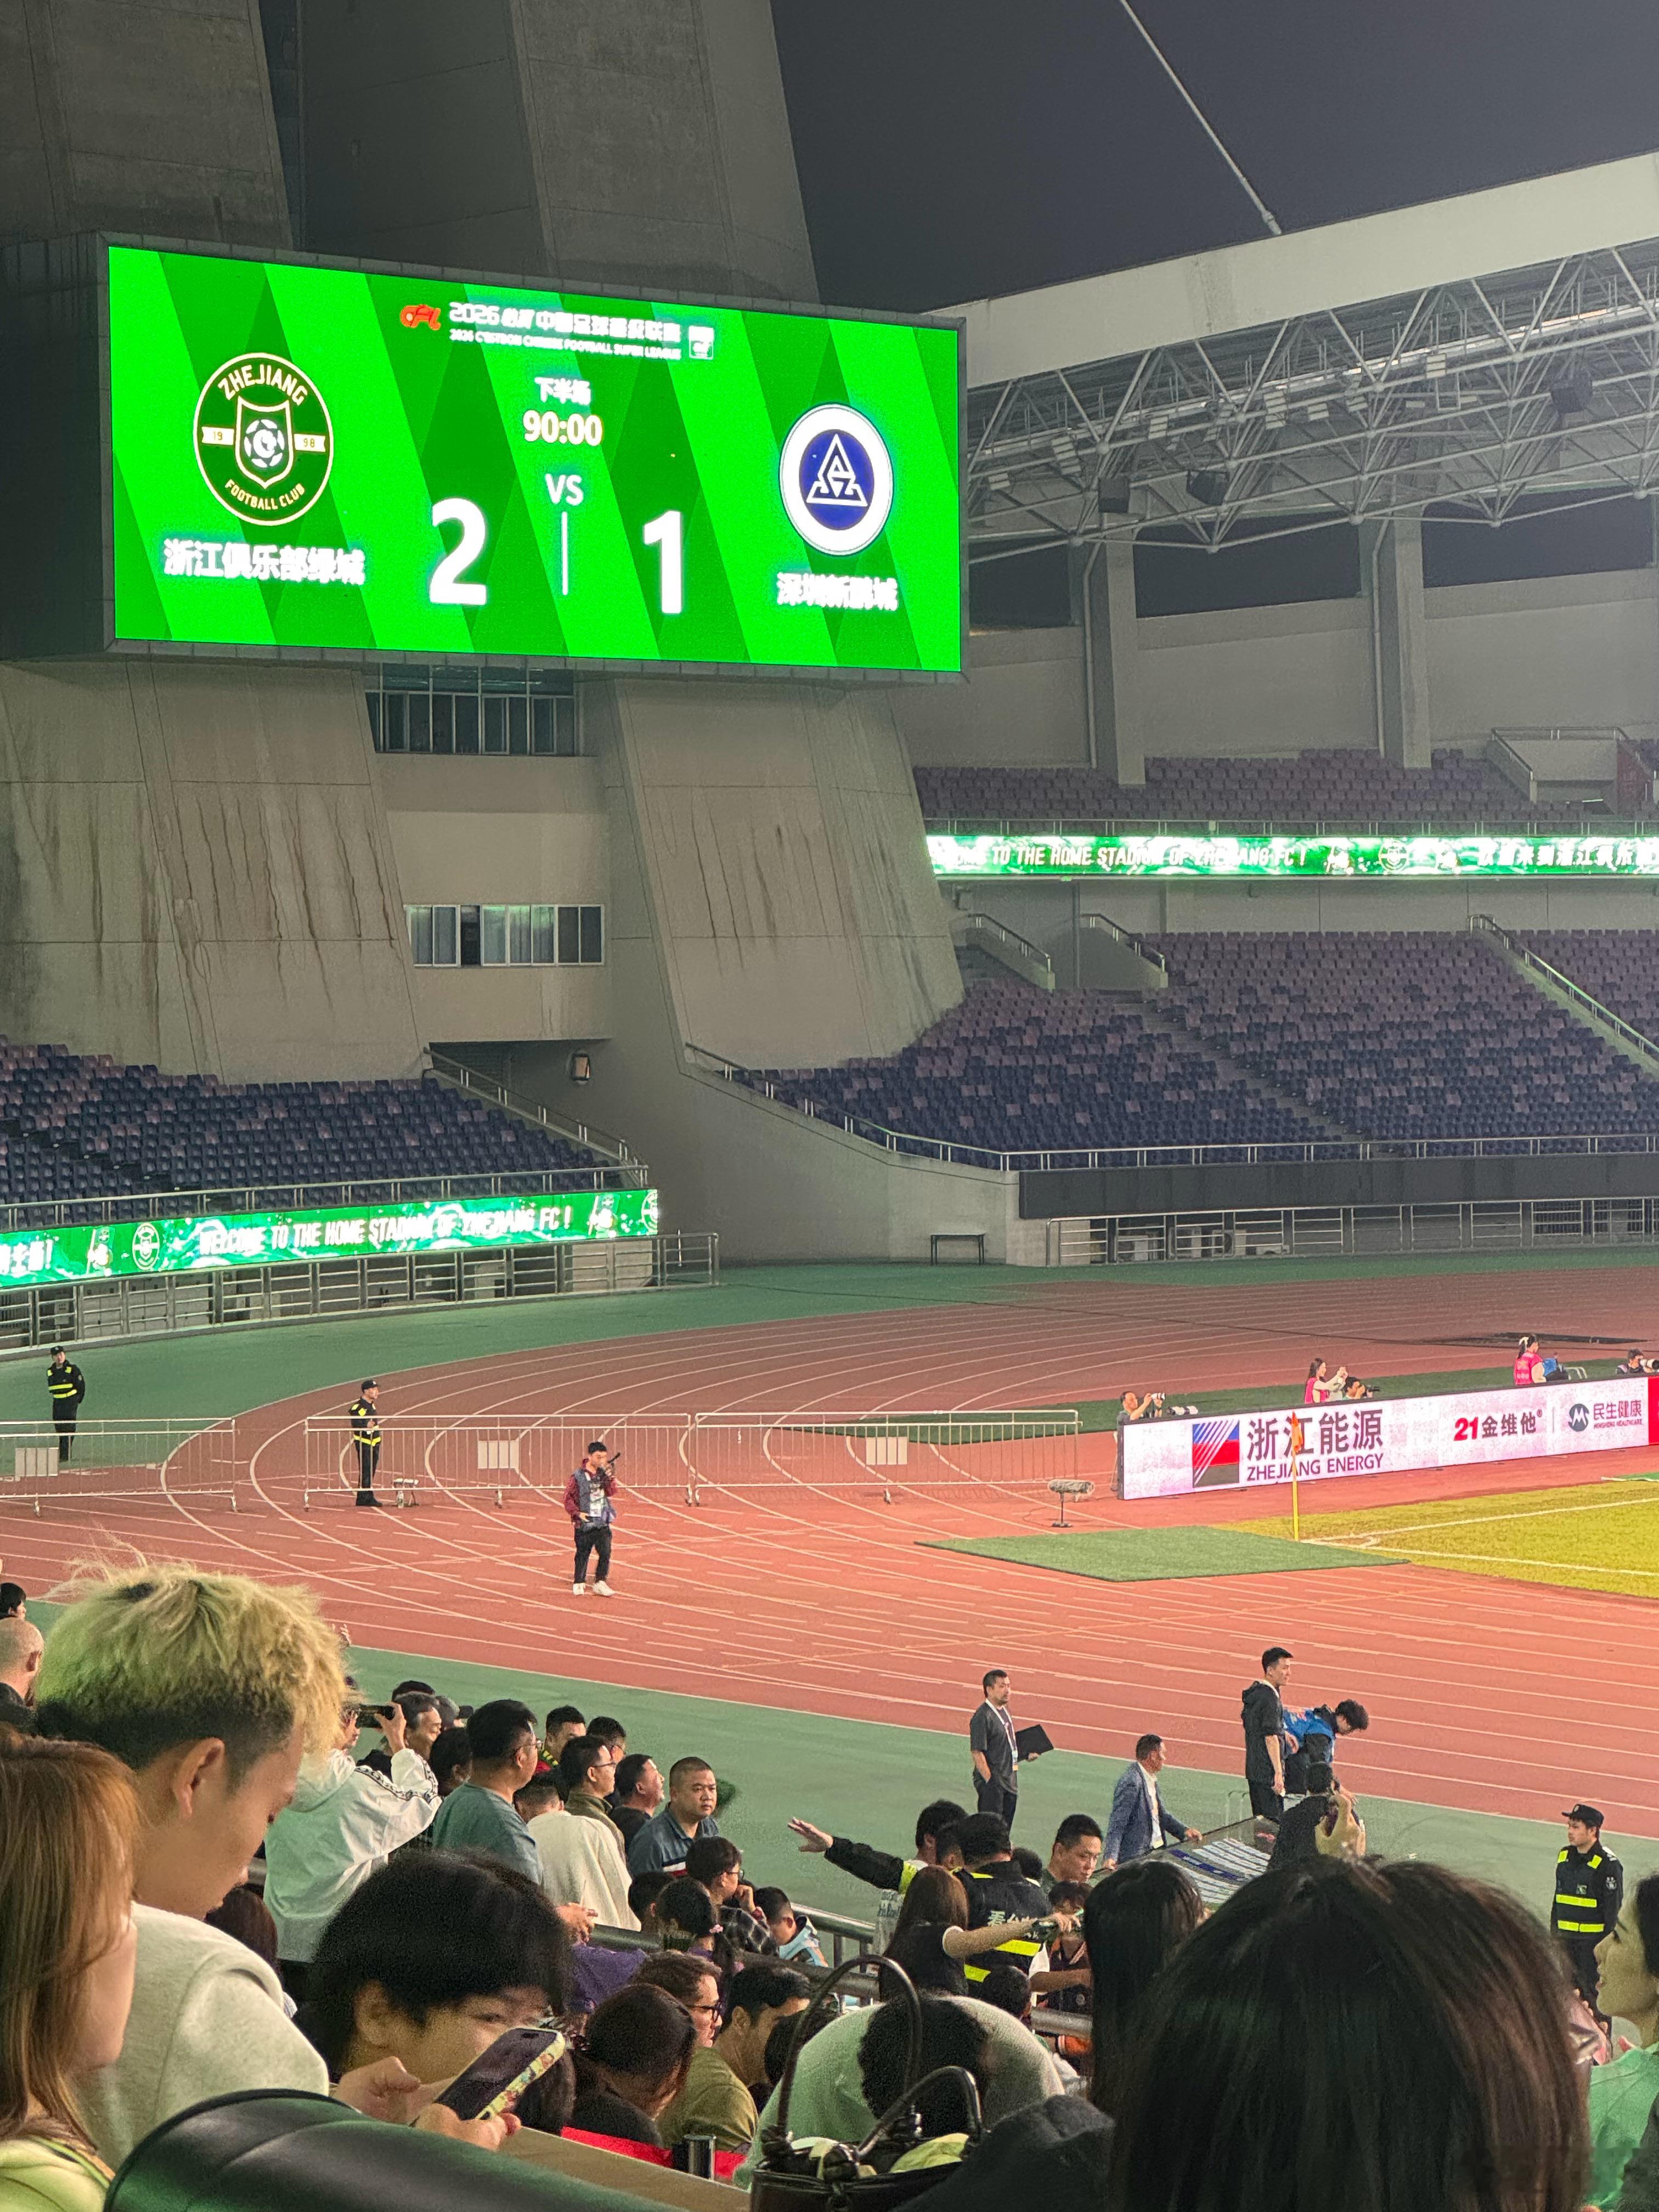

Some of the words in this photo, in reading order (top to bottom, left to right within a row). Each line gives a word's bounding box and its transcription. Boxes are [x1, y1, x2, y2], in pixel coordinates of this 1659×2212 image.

[449, 302, 500, 325] 2026
[218, 364, 307, 405] ZHEJIANG
[212, 431, 223, 441] 19
[303, 438, 315, 448] 98
[523, 410, 603, 446] 90:00
[224, 479, 278, 510] FOOTBALL
[279, 483, 305, 507] CLUB
[545, 473, 584, 506] VS
[164, 539, 365, 585] 浙江俱乐部绿城
[429, 498, 487, 605] 2
[643, 510, 683, 615] 1
[991, 846, 1011, 865] TO
[1016, 846, 1045, 865] THE
[1050, 846, 1093, 865] HOME
[1195, 848, 1269, 866] ZHEANG
[271, 1225, 289, 1250] TO
[293, 1223, 321, 1248] THE
[325, 1220, 366, 1245] HOME
[437, 1214, 456, 1238] OF
[1593, 1400, 1642, 1420] 民生健康
[1247, 1409, 1384, 1461] 浙江能源
[1247, 1458, 1321, 1481] ZHEJIANG
[1327, 1454, 1384, 1474] ENERGY
